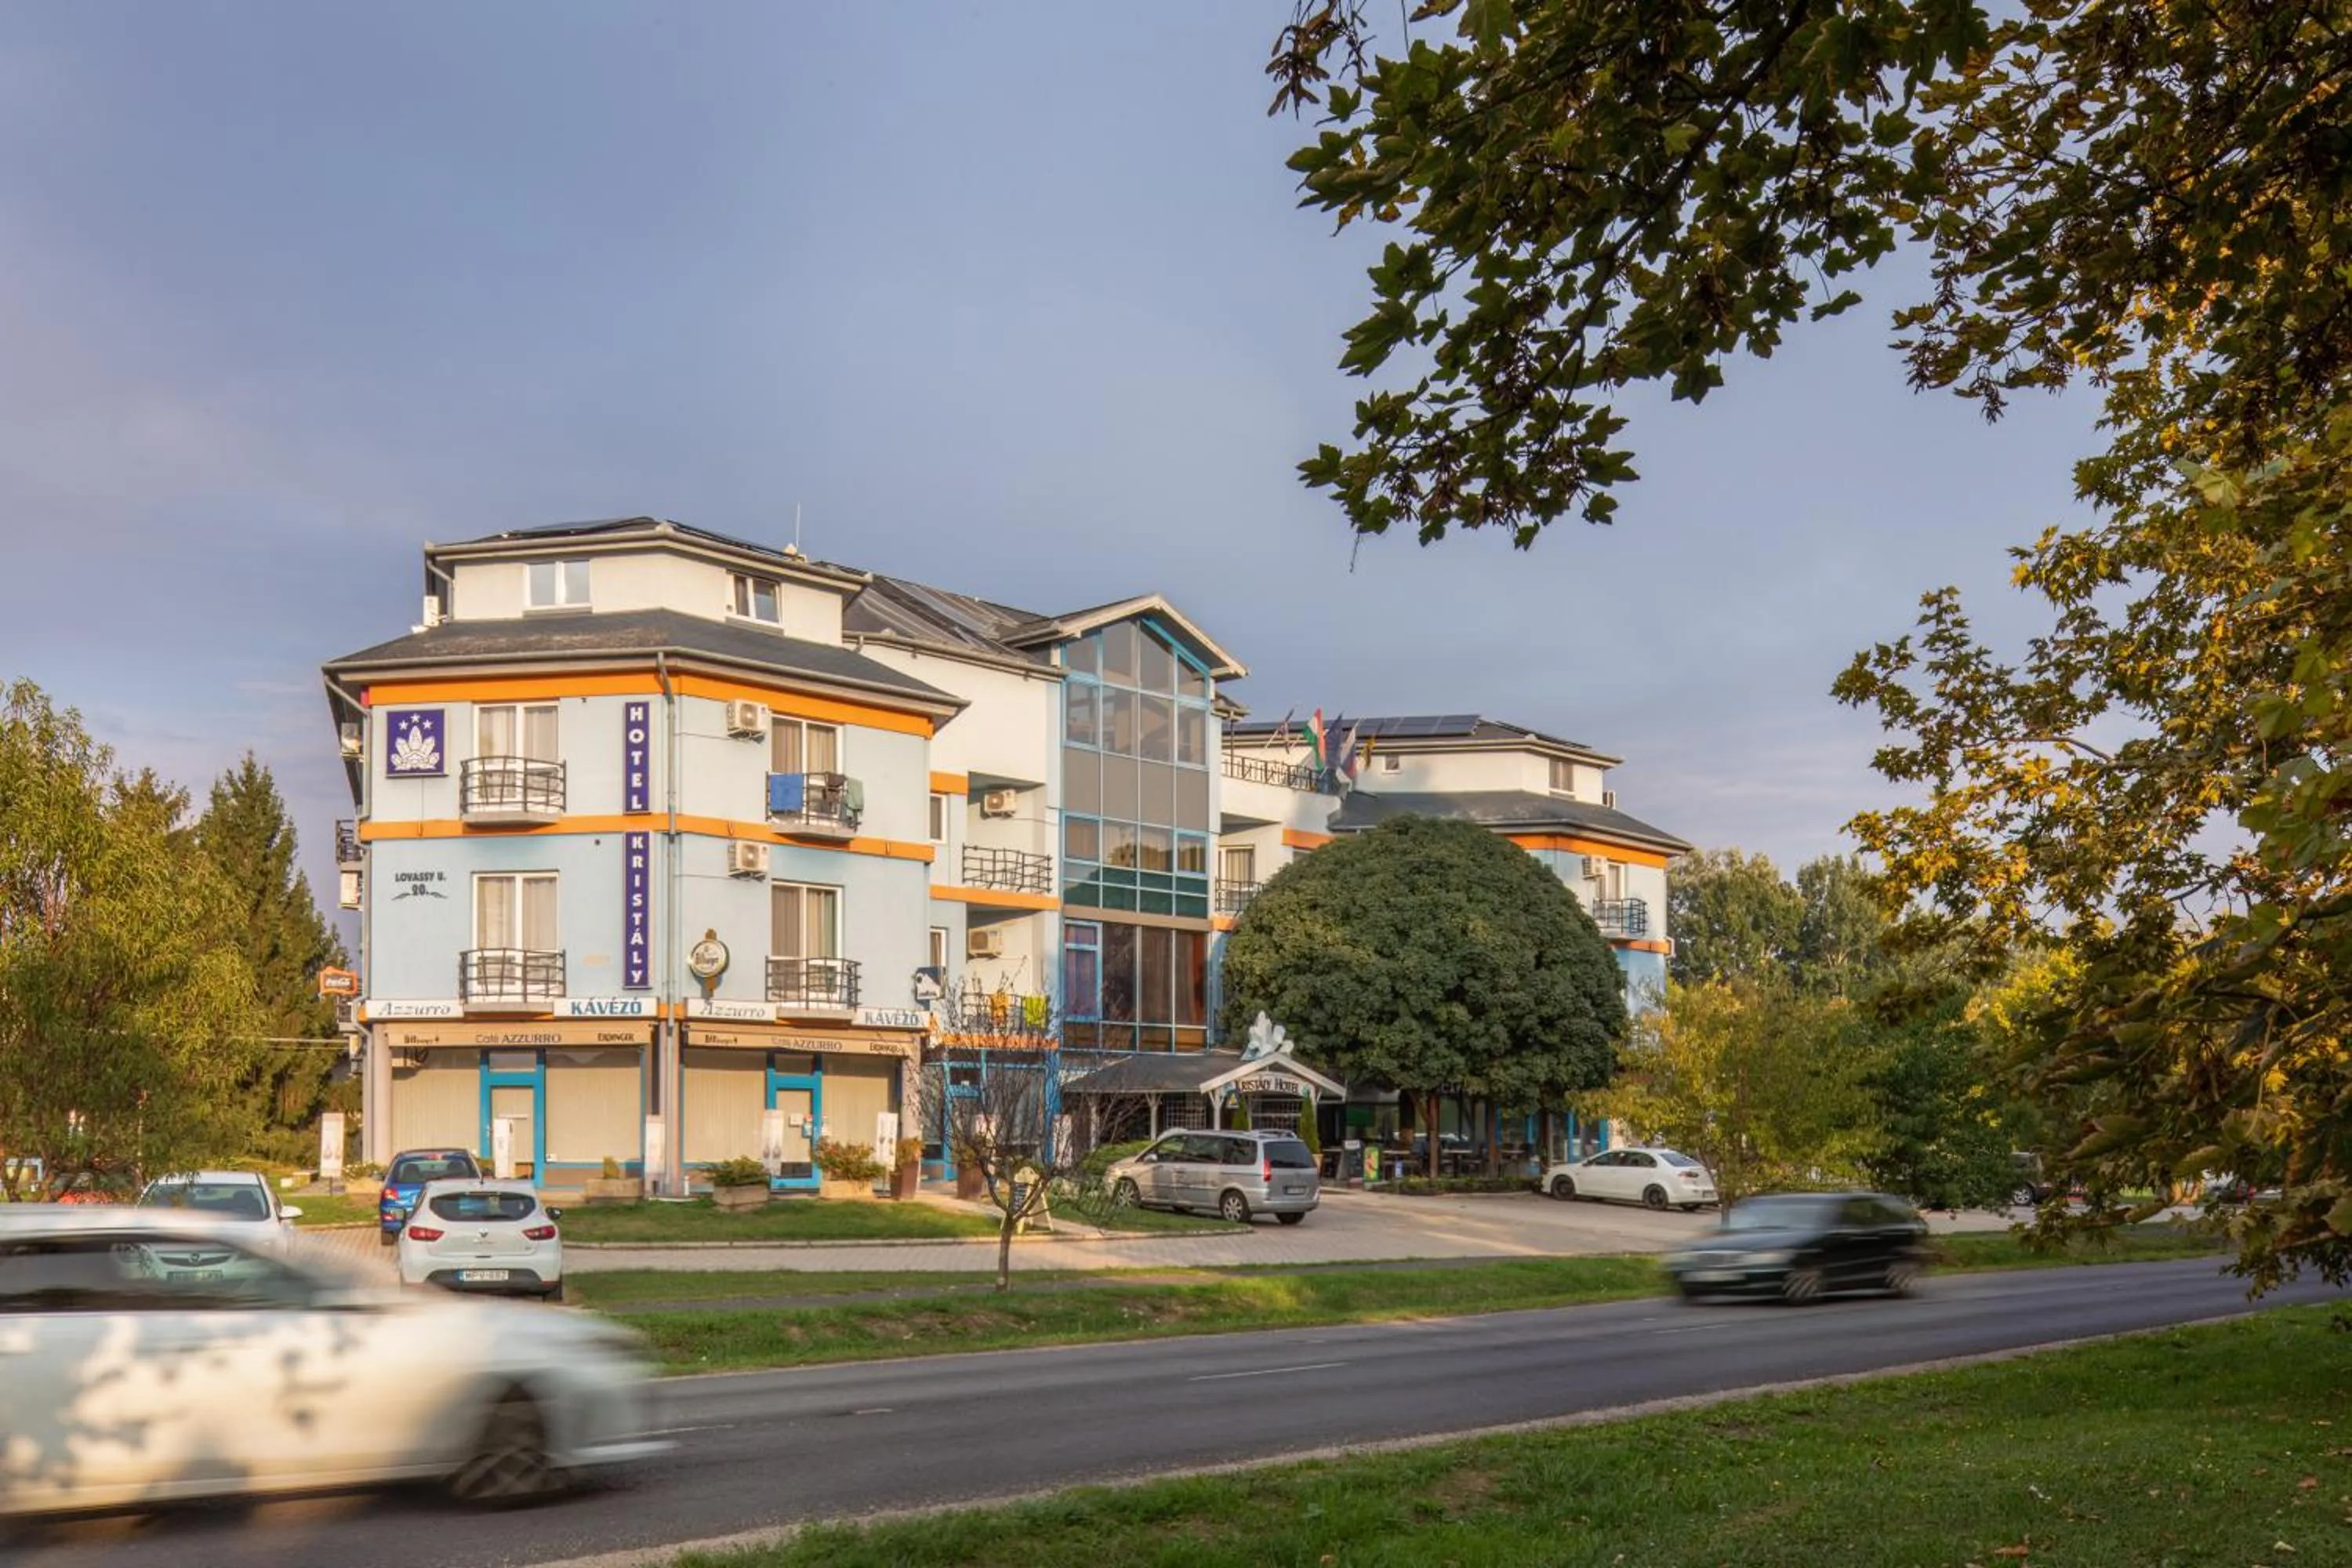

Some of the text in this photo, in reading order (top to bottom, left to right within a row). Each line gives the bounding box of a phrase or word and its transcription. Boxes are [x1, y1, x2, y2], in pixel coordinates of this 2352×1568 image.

[628, 706, 644, 810] HOTEL
[630, 836, 644, 983] KRISTÁLY
[378, 1002, 452, 1016] Azzurro
[570, 997, 643, 1015] KÁVÉZÓ
[699, 1001, 766, 1018] Azzurro
[502, 1033, 562, 1044] AZZURRO
